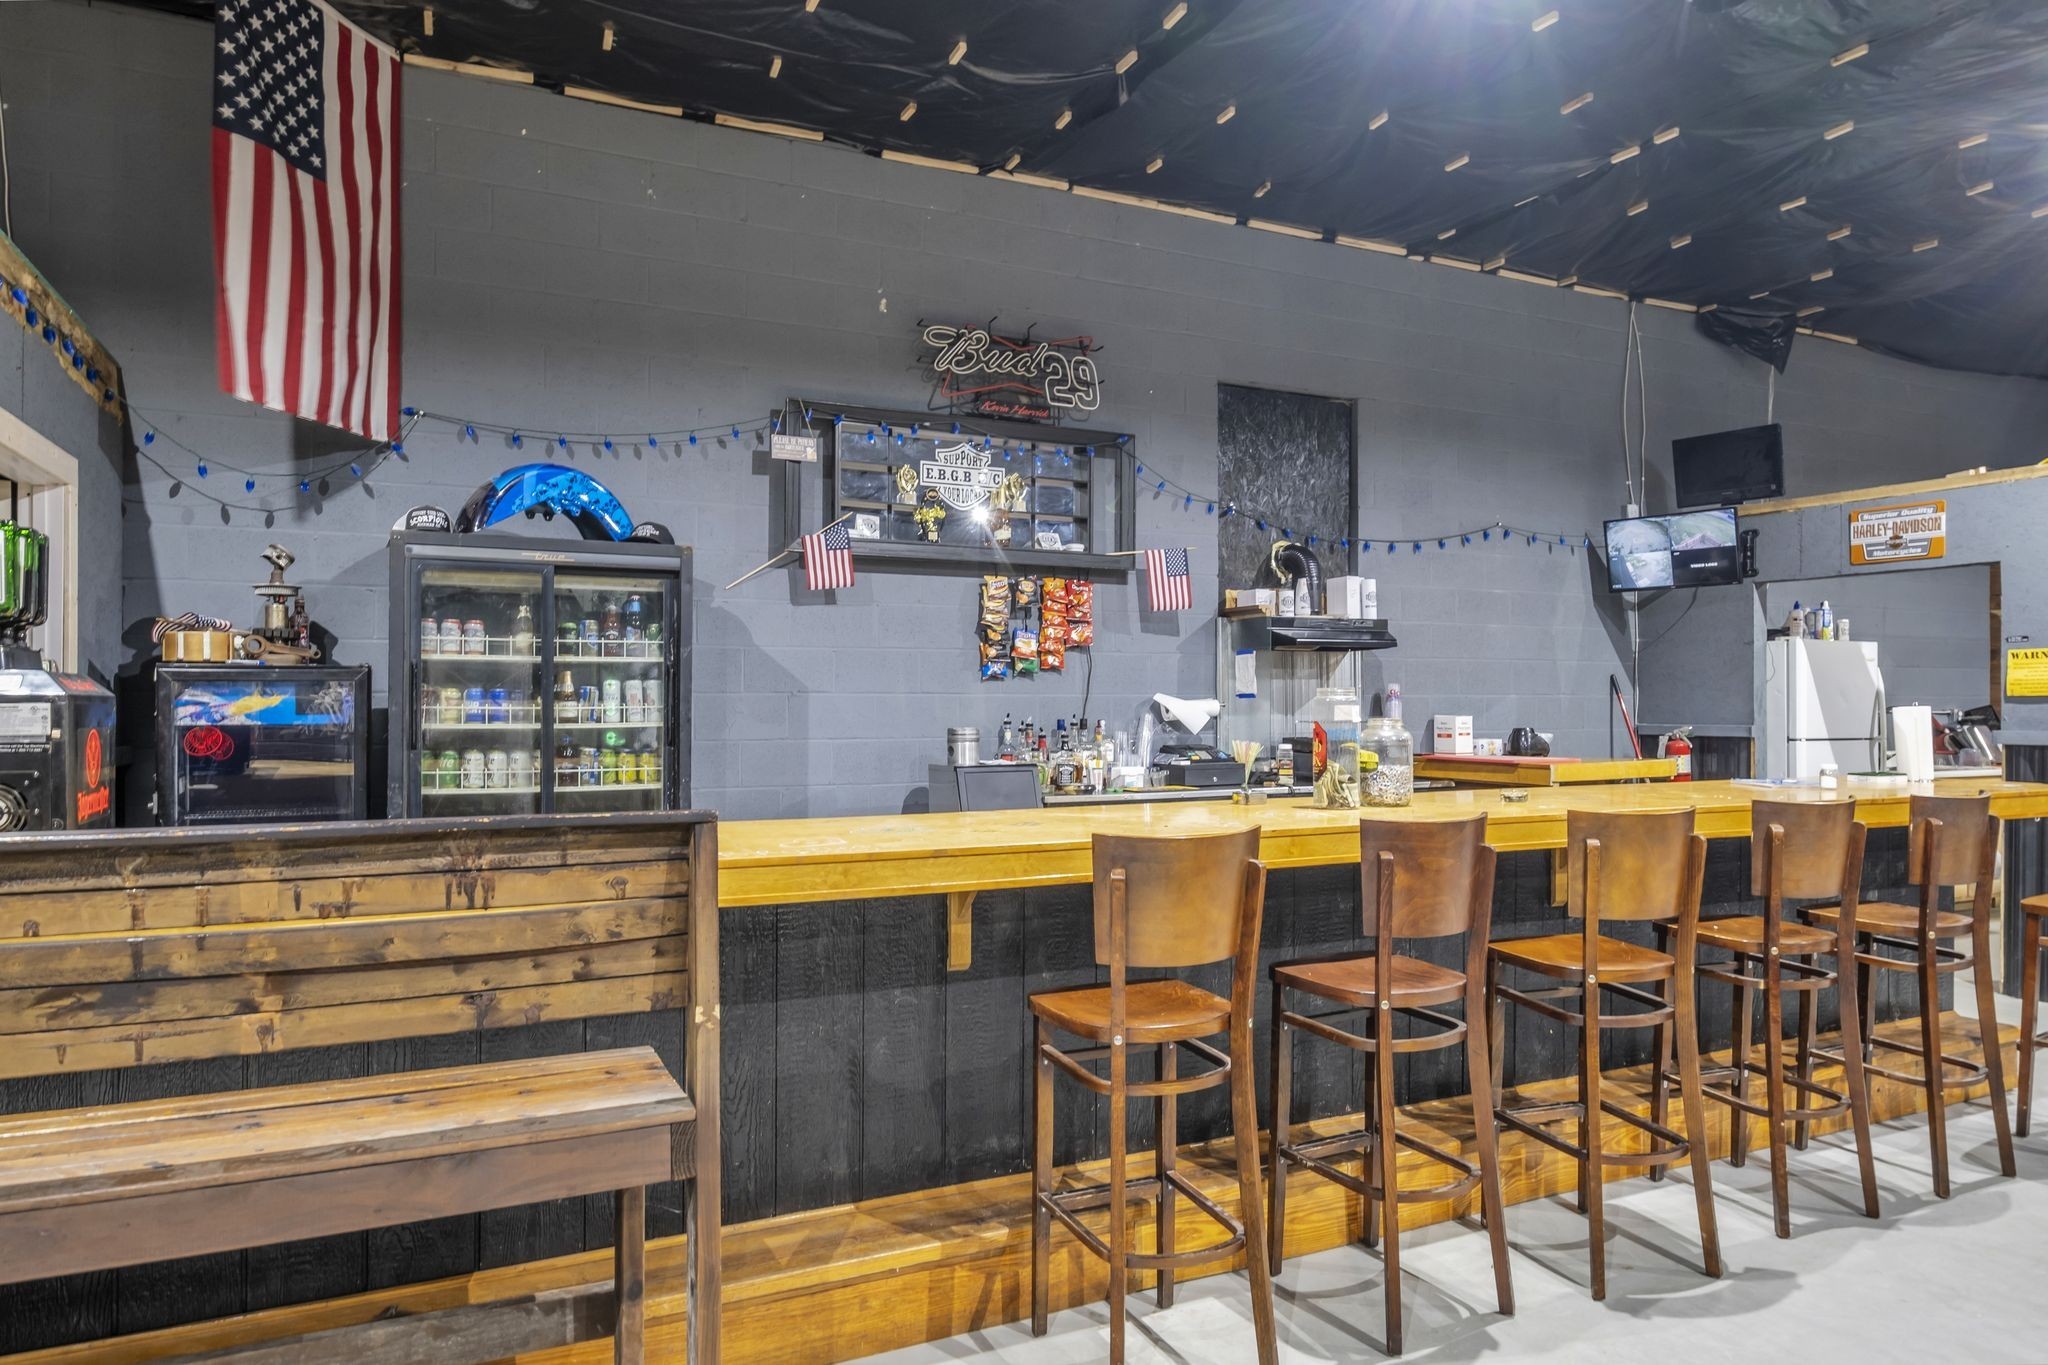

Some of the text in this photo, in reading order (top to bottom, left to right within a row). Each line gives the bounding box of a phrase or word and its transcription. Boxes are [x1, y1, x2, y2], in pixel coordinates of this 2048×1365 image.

[923, 325, 1100, 410] Bud 29
[980, 400, 1050, 419] Kevin Harvick
[943, 450, 984, 468] SUPPORT
[943, 486, 961, 503] YOUR
[1862, 507, 1935, 520] Superior Quality
[1852, 516, 1943, 540] HARLEY-DAVIDSON
[1872, 547, 1923, 557] Motorcycles
